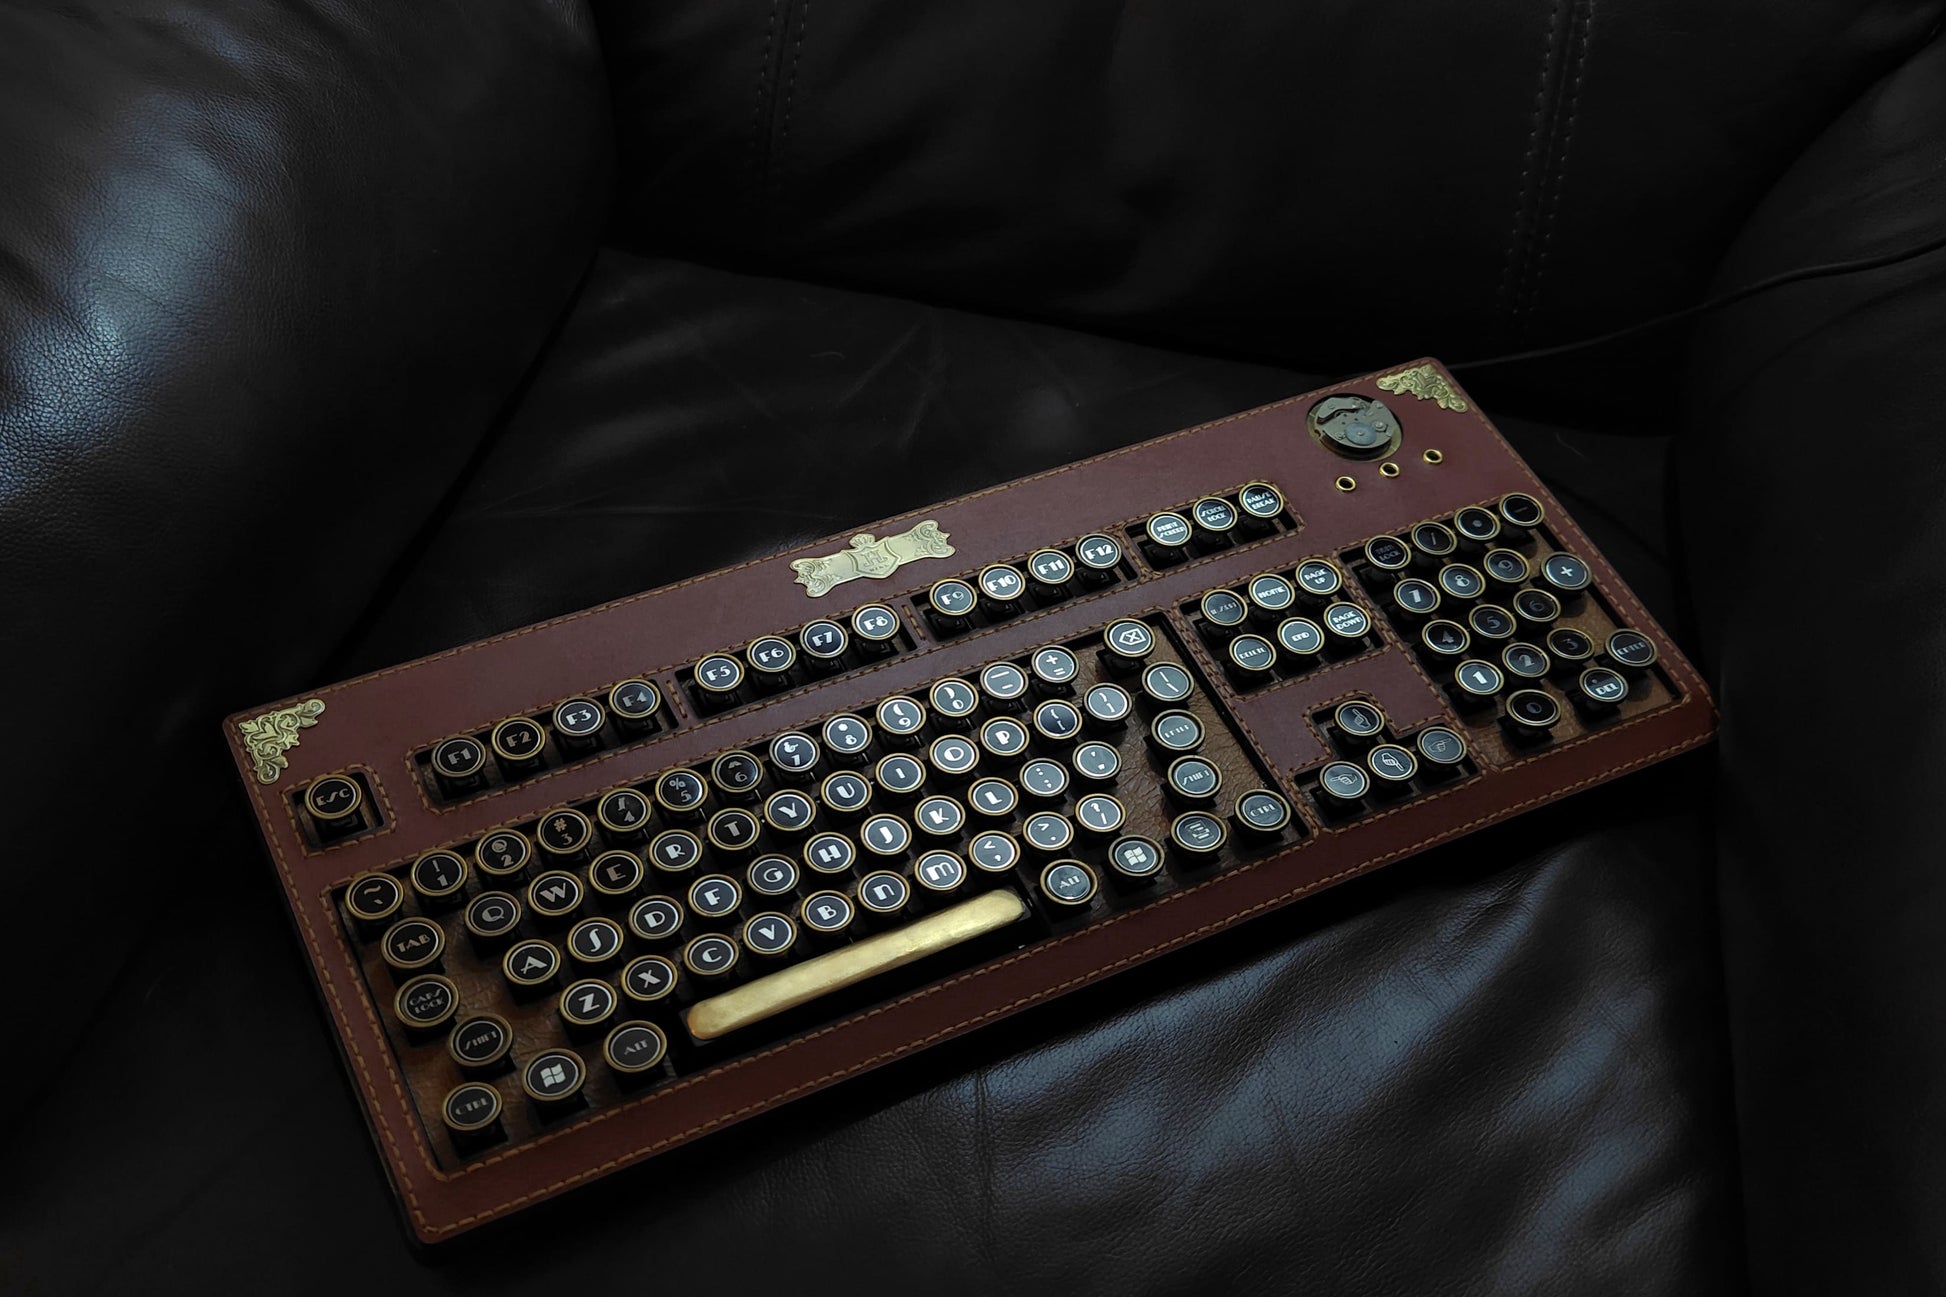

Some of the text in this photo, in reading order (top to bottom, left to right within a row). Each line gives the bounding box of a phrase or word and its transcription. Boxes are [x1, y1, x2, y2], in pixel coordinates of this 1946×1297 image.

[1085, 545, 1114, 559] F12
[1038, 560, 1064, 574] F11
[1498, 560, 1513, 572] 9
[987, 575, 1016, 592] F10
[1455, 575, 1470, 586] 8
[941, 592, 964, 604] F9
[1529, 600, 1545, 611] 6
[864, 616, 888, 630] F8
[1487, 616, 1500, 628] 5
[812, 631, 832, 646] F7
[759, 648, 784, 662] F6
[707, 666, 730, 680] F5
[622, 691, 647, 708] F4
[566, 710, 591, 725] F3
[506, 731, 531, 747] F2
[846, 735, 857, 745] 8
[995, 731, 1010, 744] P
[448, 748, 471, 764] F1
[944, 747, 964, 761] O
[735, 772, 748, 782] 6
[316, 789, 349, 806] ESC
[681, 790, 692, 802] 5
[836, 783, 855, 798] U
[985, 792, 1002, 804] L
[778, 803, 797, 818] Y
[929, 808, 949, 824] K
[724, 821, 740, 836] T
[880, 827, 893, 843] J
[562, 833, 572, 845] 3
[666, 844, 685, 859] R
[818, 845, 841, 862] H
[501, 855, 514, 866] 2
[606, 864, 626, 881] E
[764, 868, 783, 882] G
[437, 875, 448, 886] 1
[540, 883, 566, 902] W
[705, 888, 720, 905] F
[482, 906, 504, 921] Q
[644, 911, 665, 927] D
[817, 906, 836, 920] B
[759, 924, 774, 940] V
[397, 935, 430, 952] TAB
[590, 929, 601, 951] S
[703, 948, 721, 962] C
[521, 956, 547, 974] A
[638, 970, 660, 988] X
[410, 989, 442, 1005] CAPS
[579, 993, 600, 1012] Z
